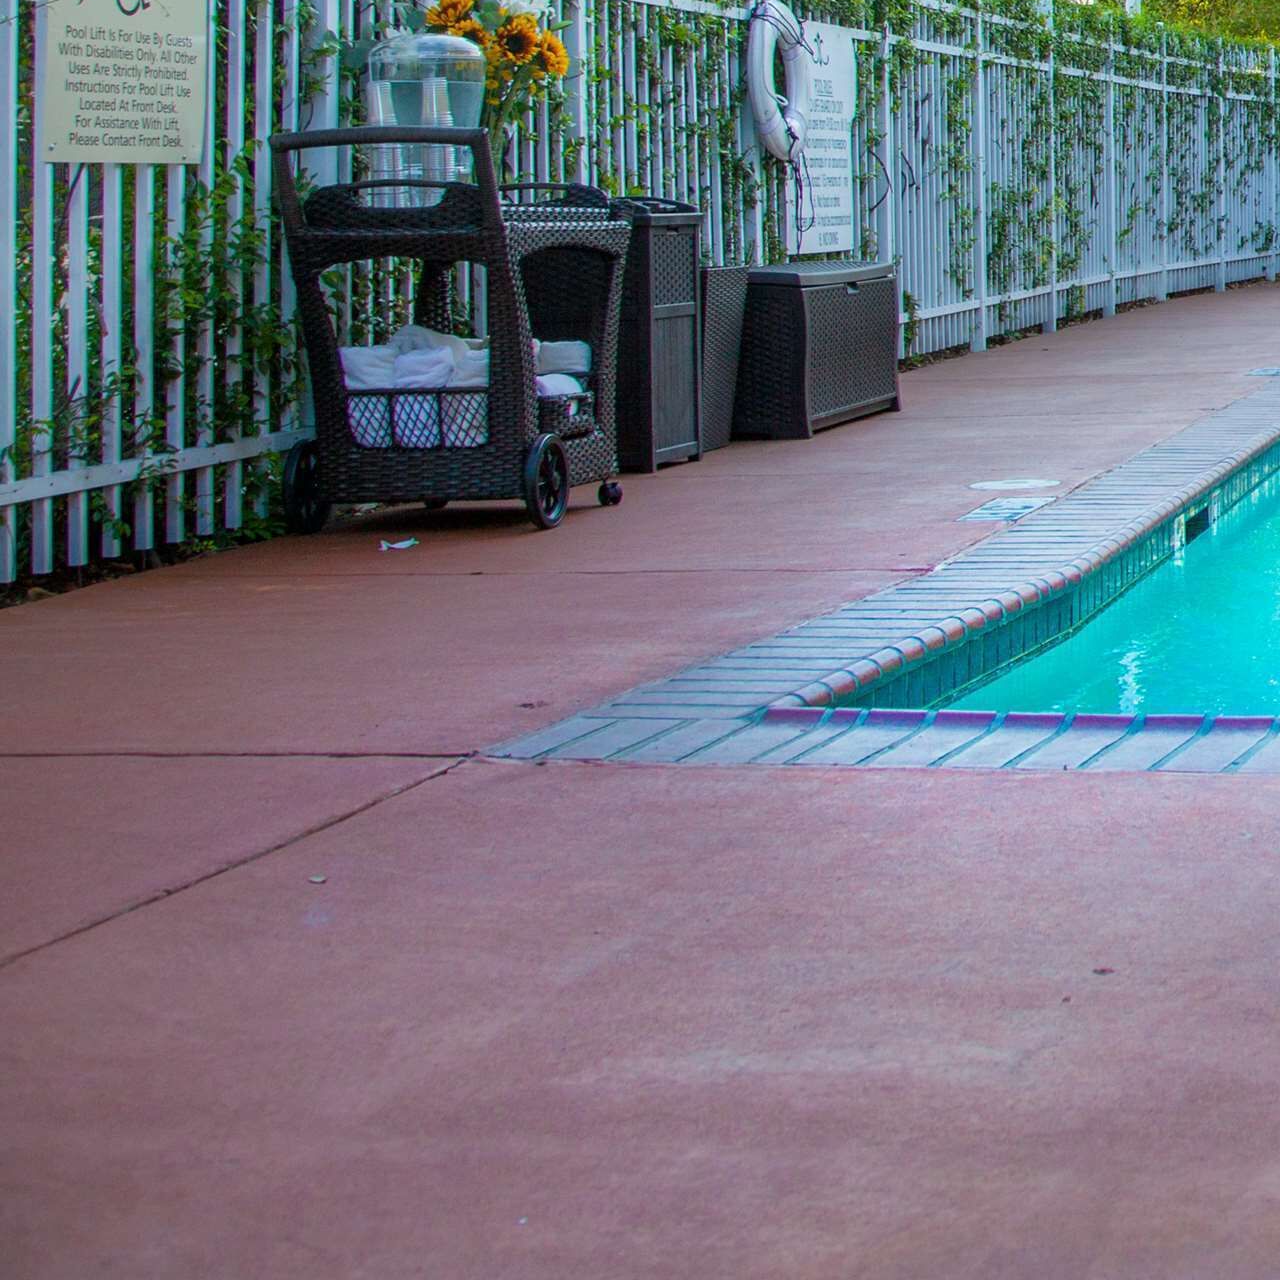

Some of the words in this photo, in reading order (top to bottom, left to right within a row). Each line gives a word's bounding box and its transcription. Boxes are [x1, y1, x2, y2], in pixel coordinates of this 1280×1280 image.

[65, 25, 87, 40] Pool
[90, 26, 106, 41] Lift
[108, 28, 116, 41] Is
[118, 29, 133, 42] For
[135, 31, 151, 45] Use
[153, 32, 164, 48] By
[165, 33, 193, 48] Guests
[58, 42, 83, 56] With
[86, 44, 134, 60] Disabilities
[136, 48, 158, 65] Only.
[160, 50, 172, 63] All
[174, 51, 198, 65] Other
[68, 61, 91, 75] Uses
[93, 62, 110, 76] Are
[112, 63, 143, 81] Strictly
[144, 66, 189, 81] Prohibited.
[65, 79, 121, 94] Instructions
[122, 82, 137, 95] For
[139, 82, 158, 96] Pool
[160, 83, 175, 97] Lift
[176, 85, 192, 98] Use
[79, 97, 116, 112] Located
[118, 99, 130, 112] At
[132, 99, 155, 113] Front
[156, 100, 179, 114] Desk.
[74, 114, 93, 128] For
[94, 115, 140, 130] Assistance
[141, 117, 162, 130] With
[68, 132, 100, 146] Please
[102, 132, 137, 147] Contact
[138, 134, 161, 147] Front
